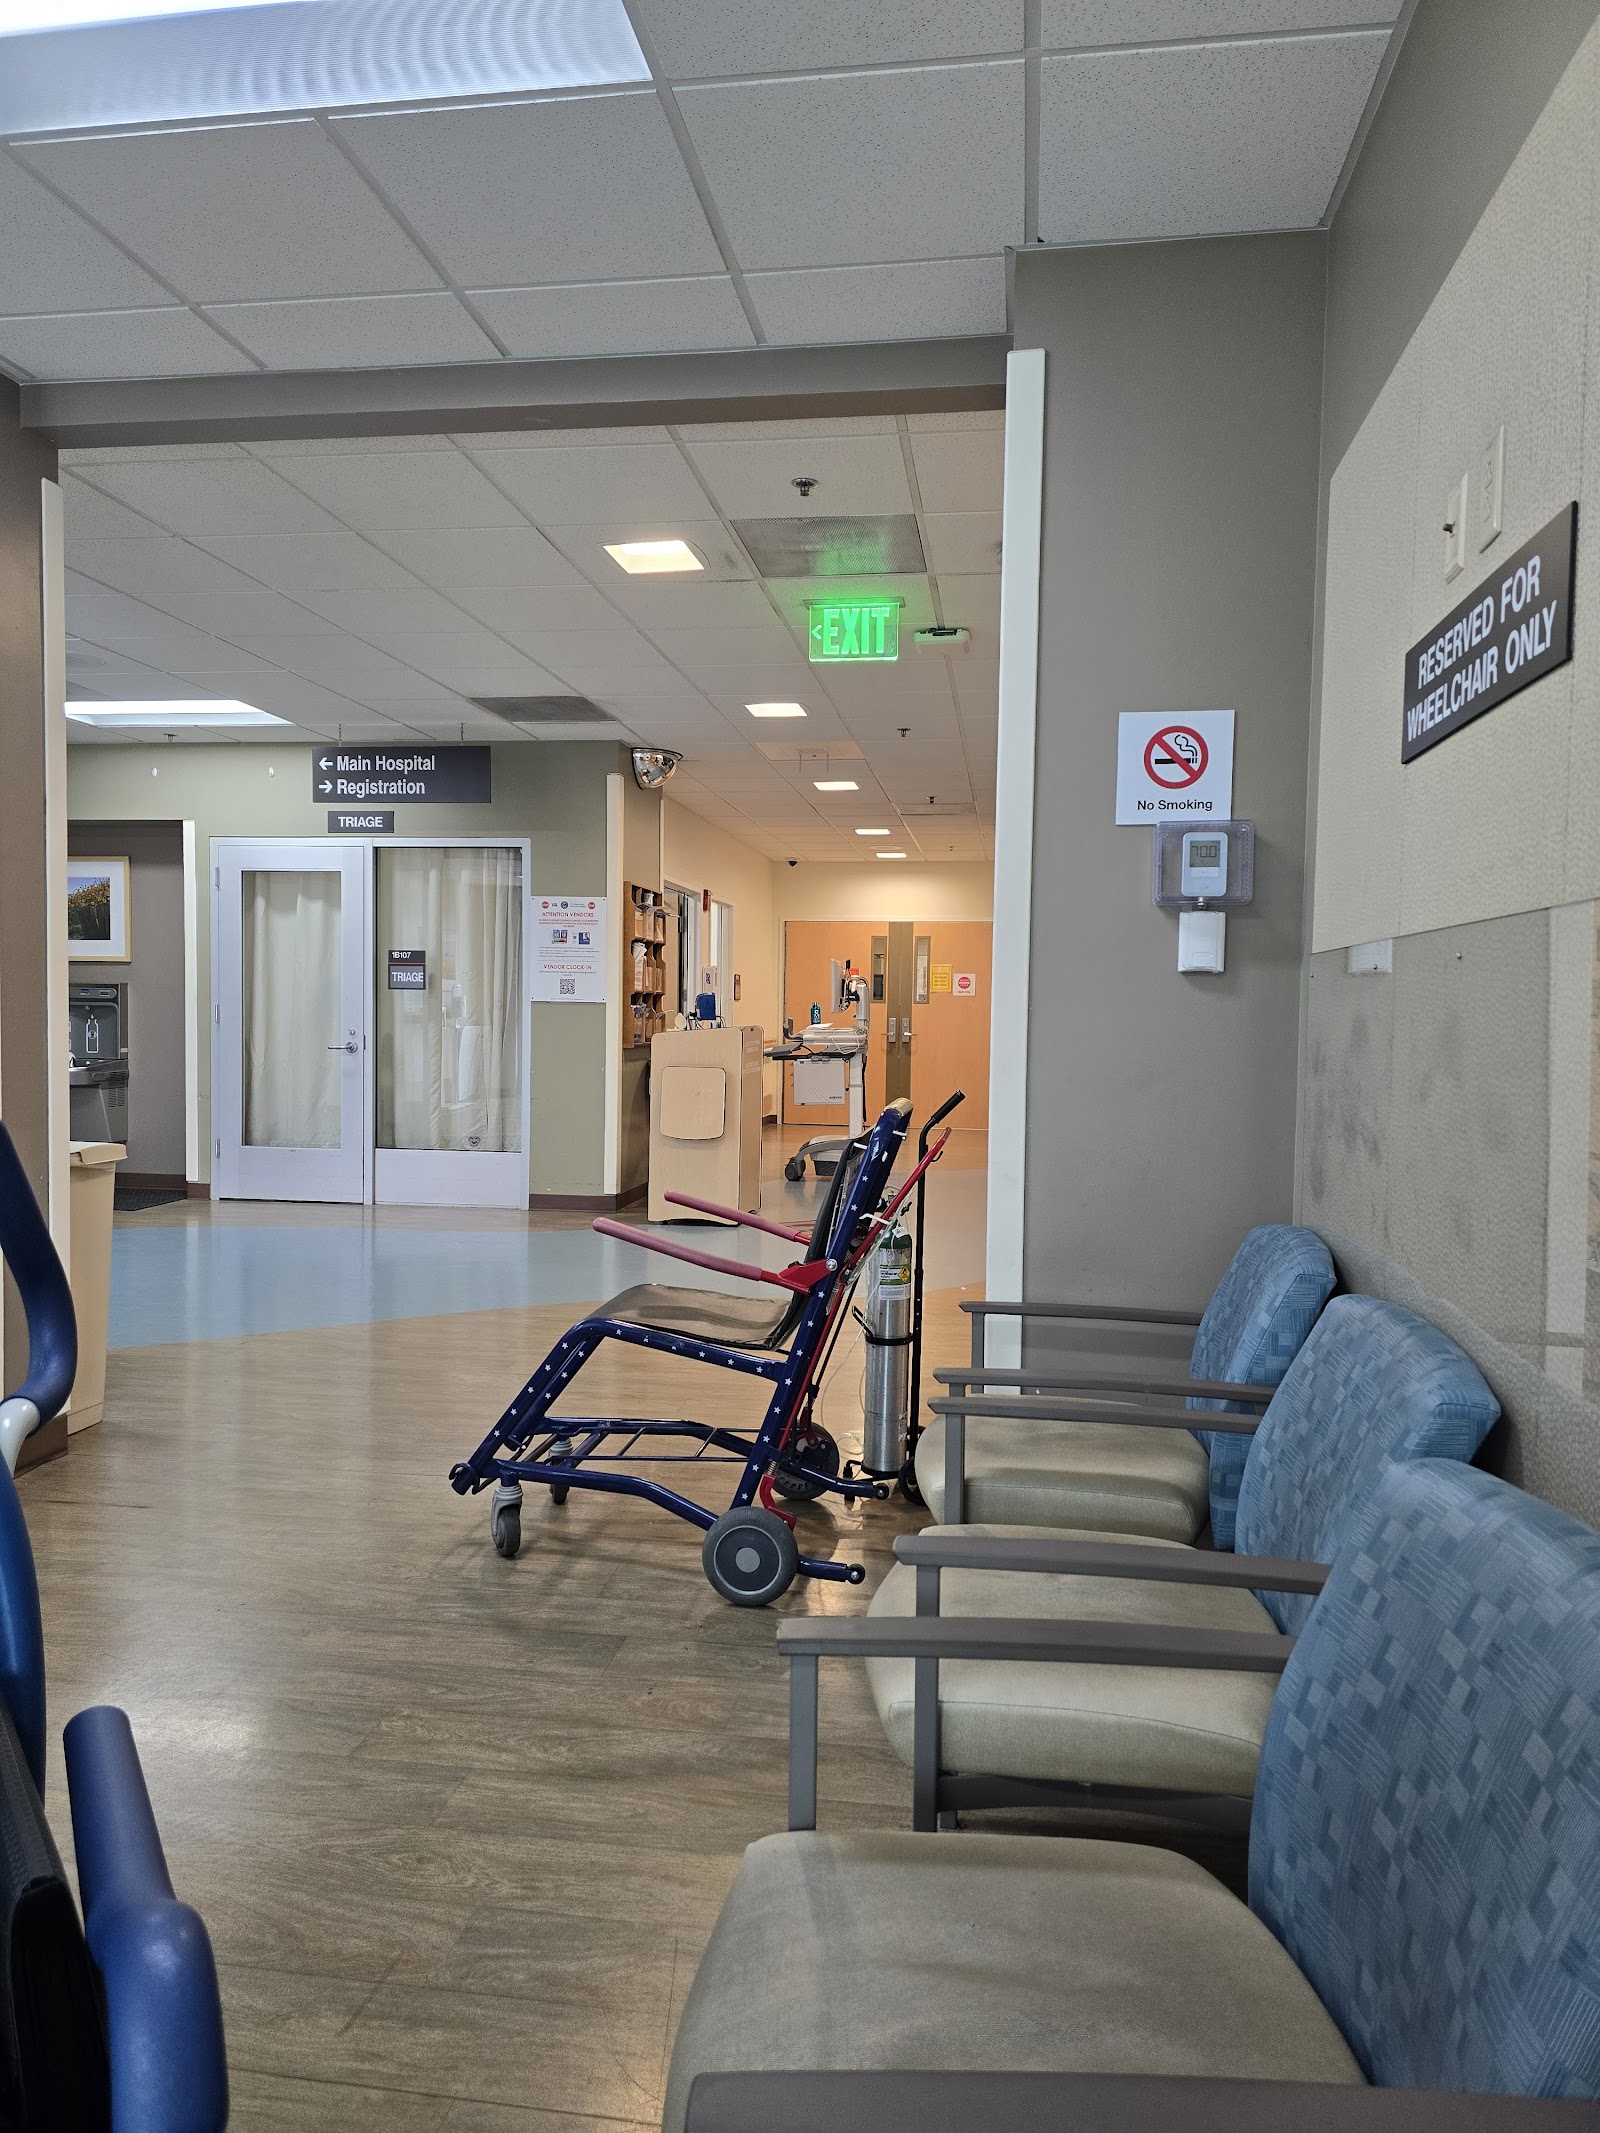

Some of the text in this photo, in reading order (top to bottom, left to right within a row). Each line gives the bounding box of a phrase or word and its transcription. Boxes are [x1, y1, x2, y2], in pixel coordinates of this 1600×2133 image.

[823, 607, 890, 655] EXIT
[1417, 554, 1541, 690] RESERVED FOR
[1406, 599, 1557, 742] WHEELCHAIR ONLY
[336, 755, 435, 775] Main Hospital
[336, 779, 426, 798] Registration
[1137, 799, 1213, 812] No Smoking
[338, 816, 384, 828] TRIAGE
[391, 951, 412, 959] 1B107
[391, 971, 424, 982] TRIAGE
